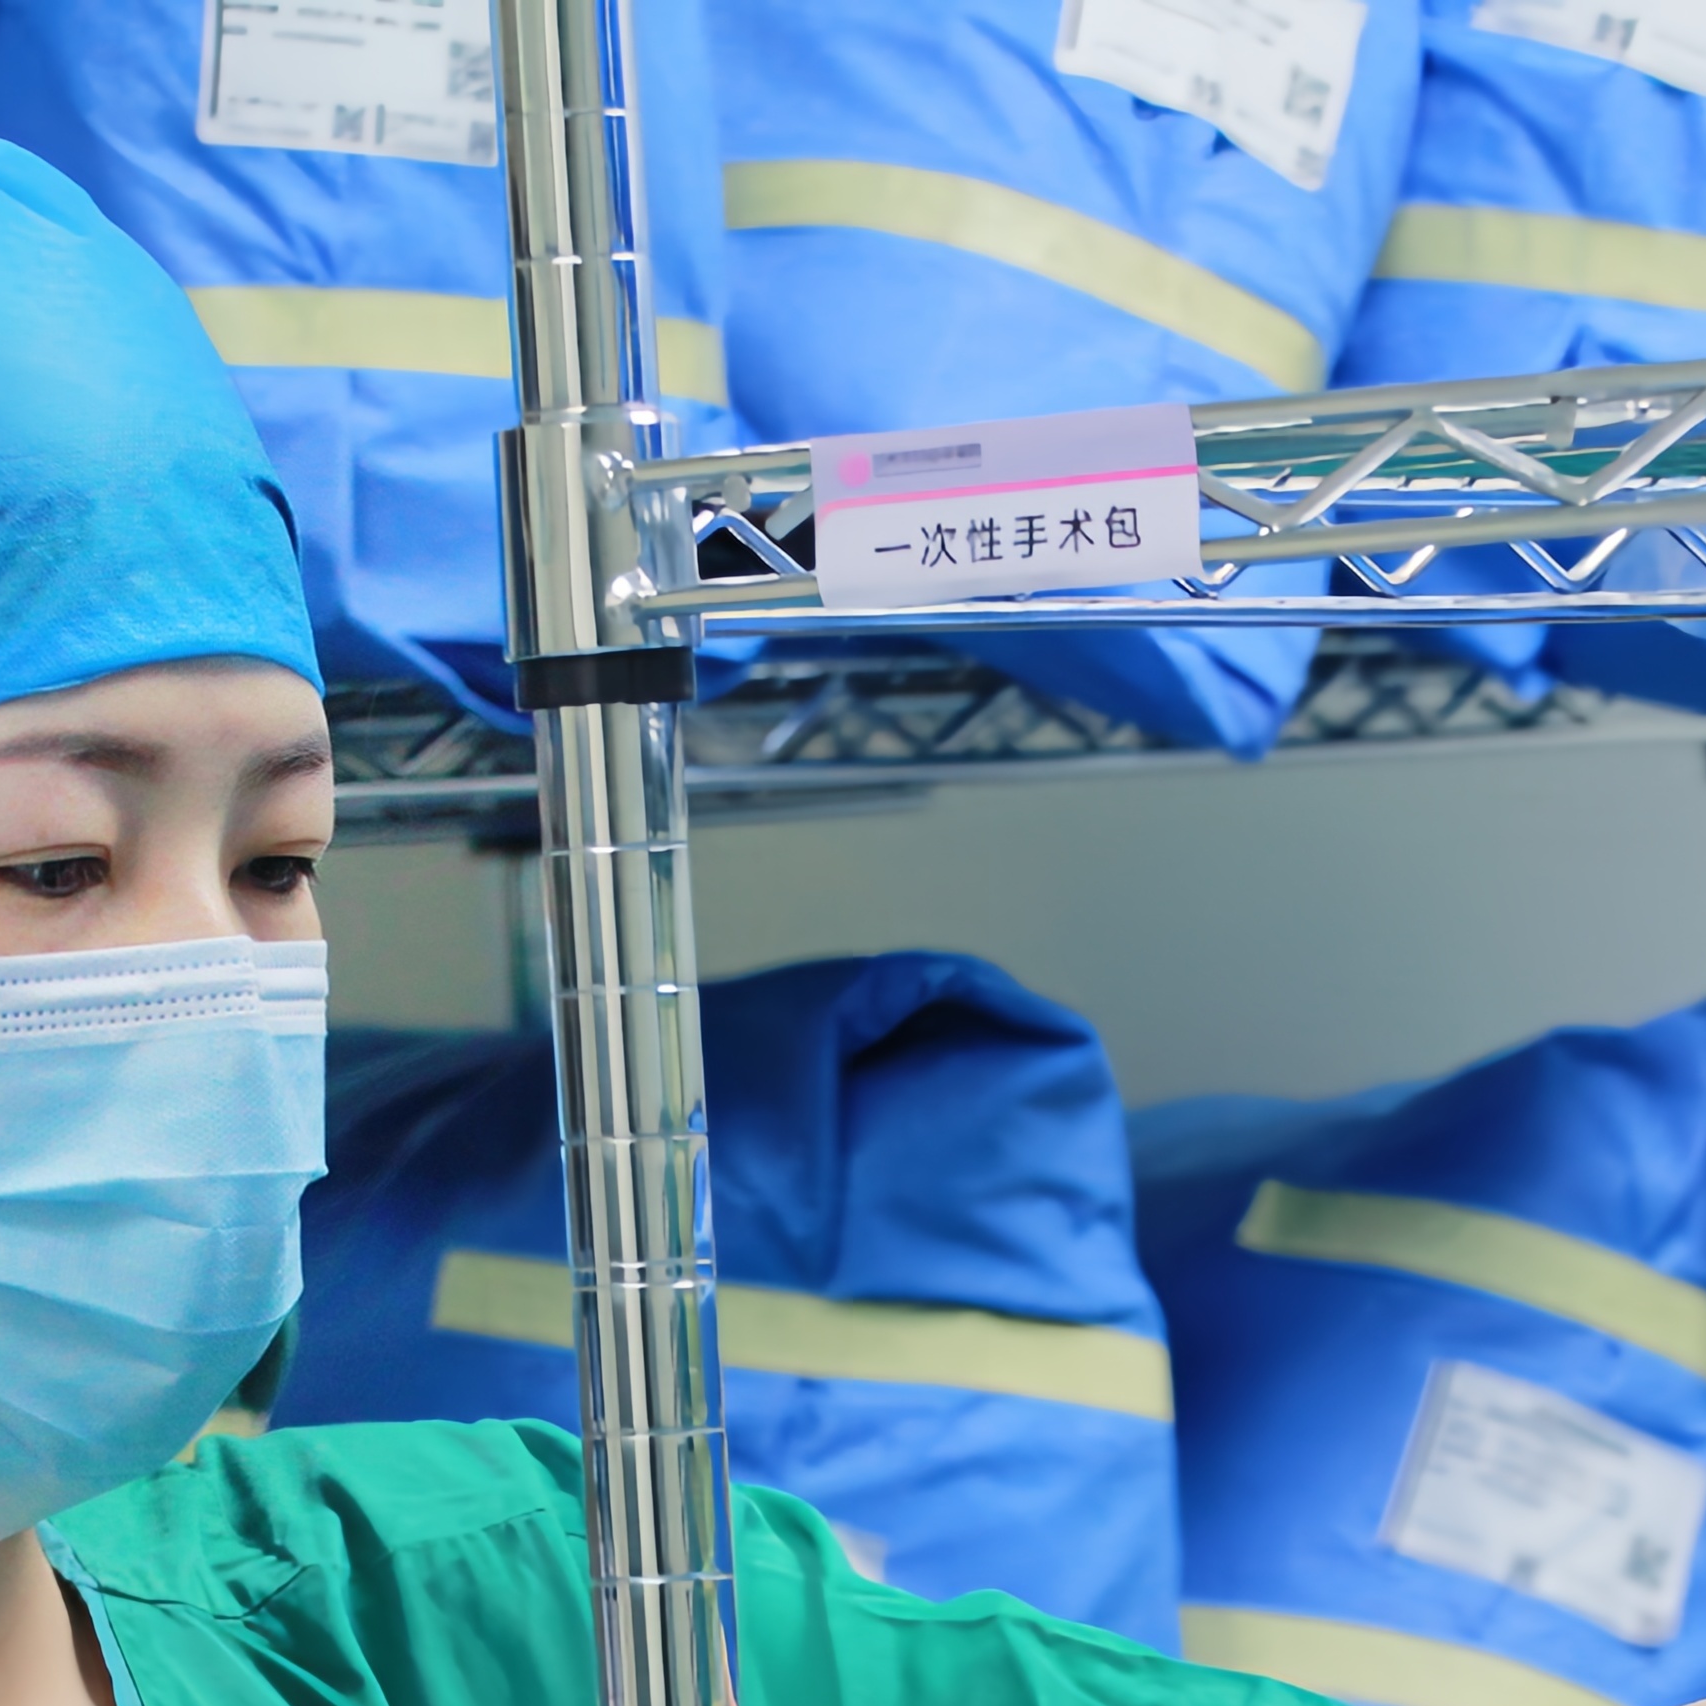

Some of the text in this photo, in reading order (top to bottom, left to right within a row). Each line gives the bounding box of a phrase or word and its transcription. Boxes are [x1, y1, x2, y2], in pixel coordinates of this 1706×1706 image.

[874, 506, 1142, 568] 一次性手术包
